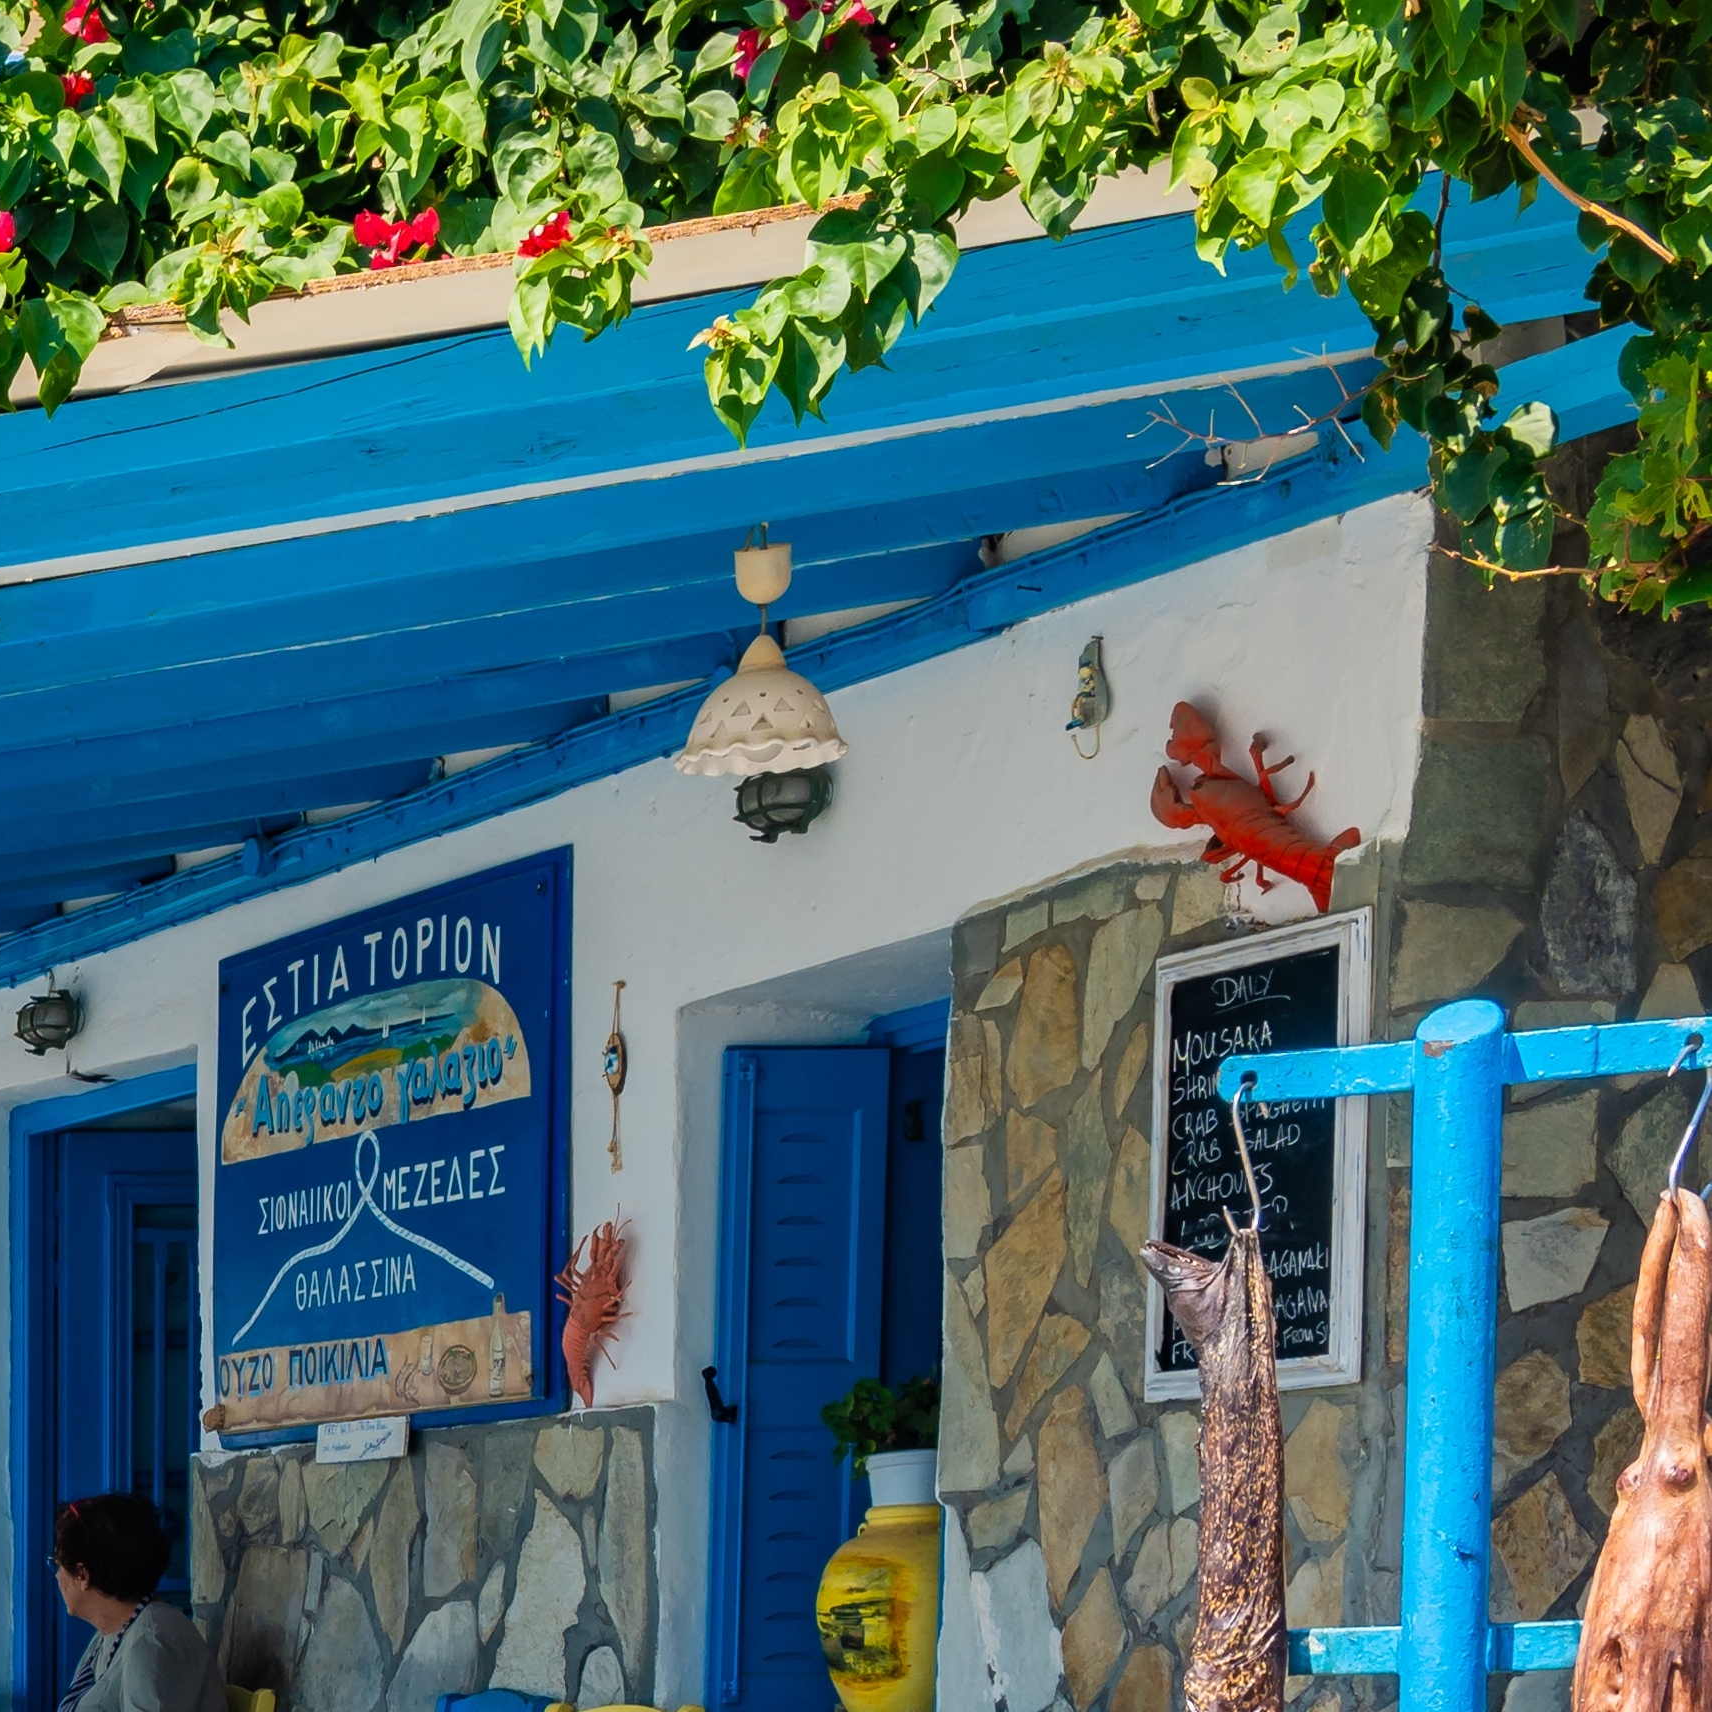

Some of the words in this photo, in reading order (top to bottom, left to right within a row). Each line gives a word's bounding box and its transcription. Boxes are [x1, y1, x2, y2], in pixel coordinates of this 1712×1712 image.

[1173, 1020, 1272, 1076] MOUSAKA
[1173, 1074, 1217, 1105] SHRI
[1172, 1108, 1219, 1141] CRAB
[383, 1145, 506, 1211] ΜΕΖΕΔΕΣ
[1172, 1138, 1222, 1175] CRAB
[295, 1253, 417, 1311] ΘΑΛΑΣΣΙΝΑ
[220, 1355, 274, 1398] ΟΥΖΟ
[289, 1338, 389, 1387] ΠΟΙΚΙΛΙΑ
